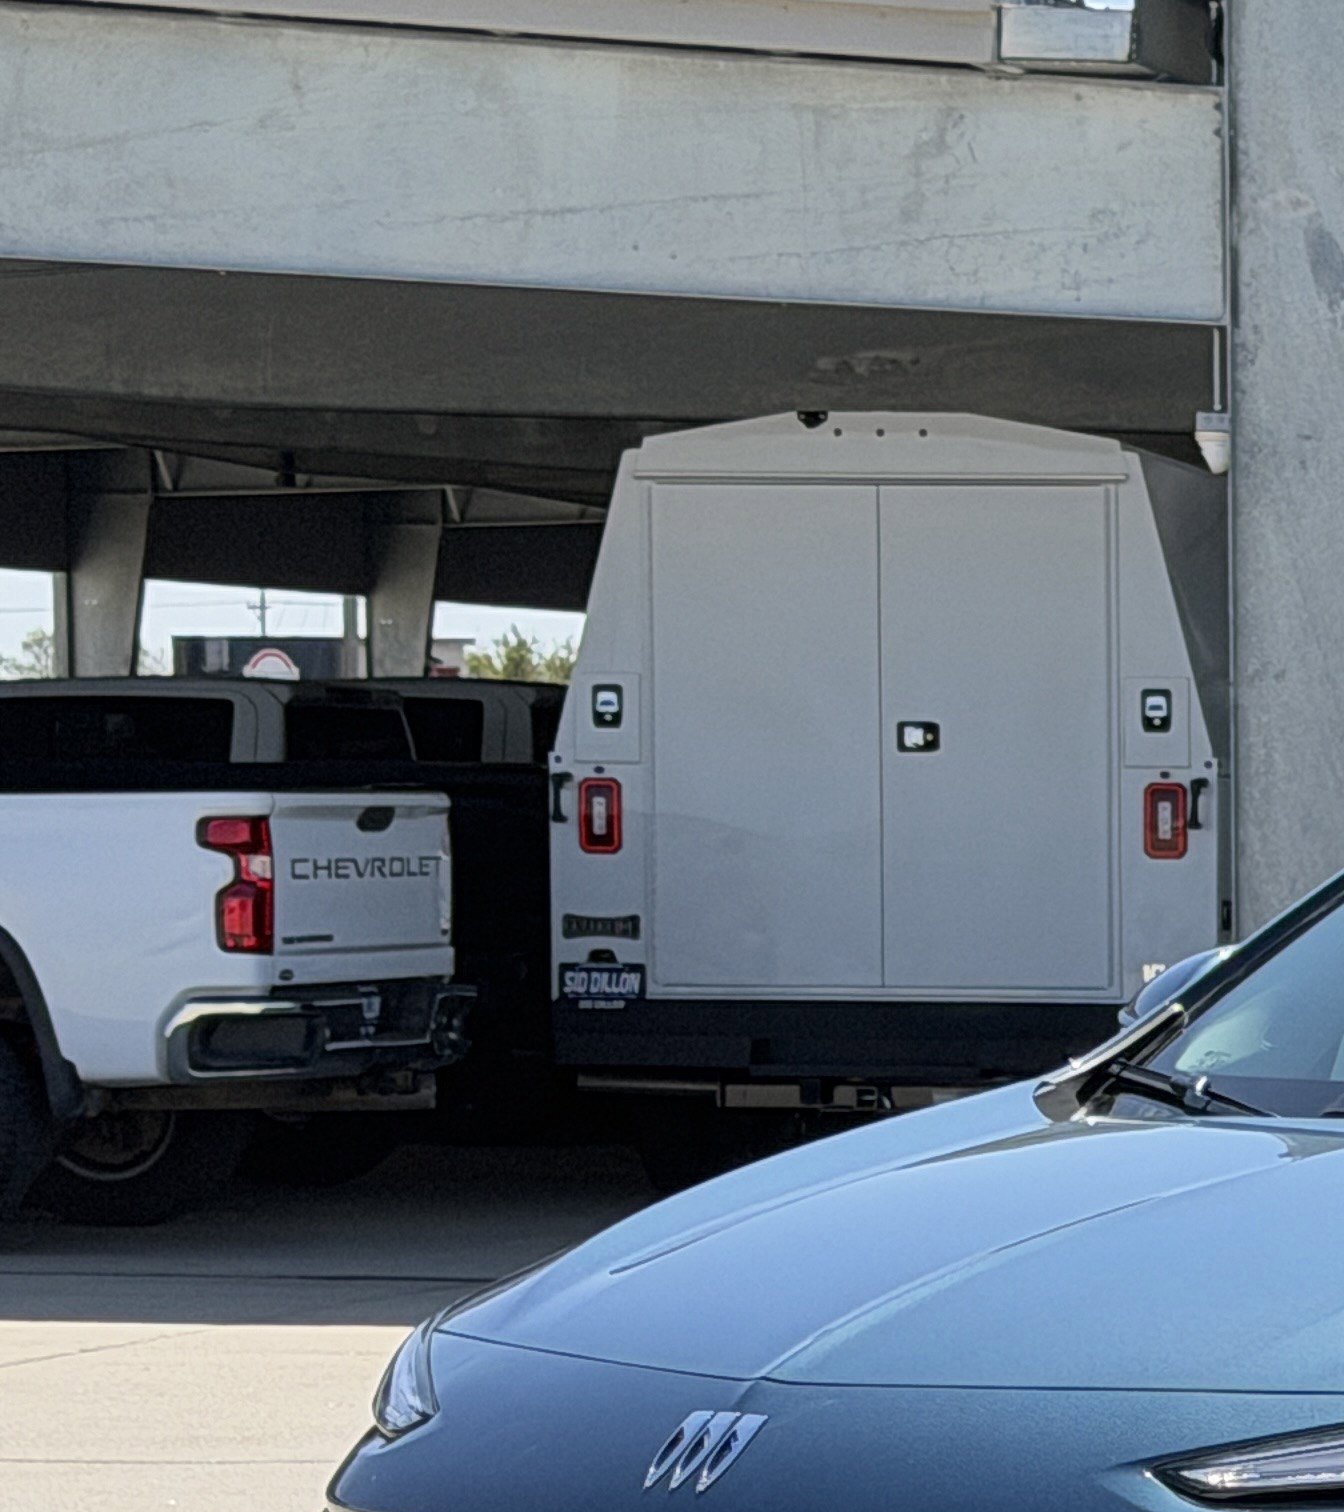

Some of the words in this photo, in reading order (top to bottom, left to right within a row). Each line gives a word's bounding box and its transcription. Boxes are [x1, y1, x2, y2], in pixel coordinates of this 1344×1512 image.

[290, 855, 442, 880] CHEVROLET
[563, 971, 588, 993] SID
[589, 971, 641, 993] DILLON
